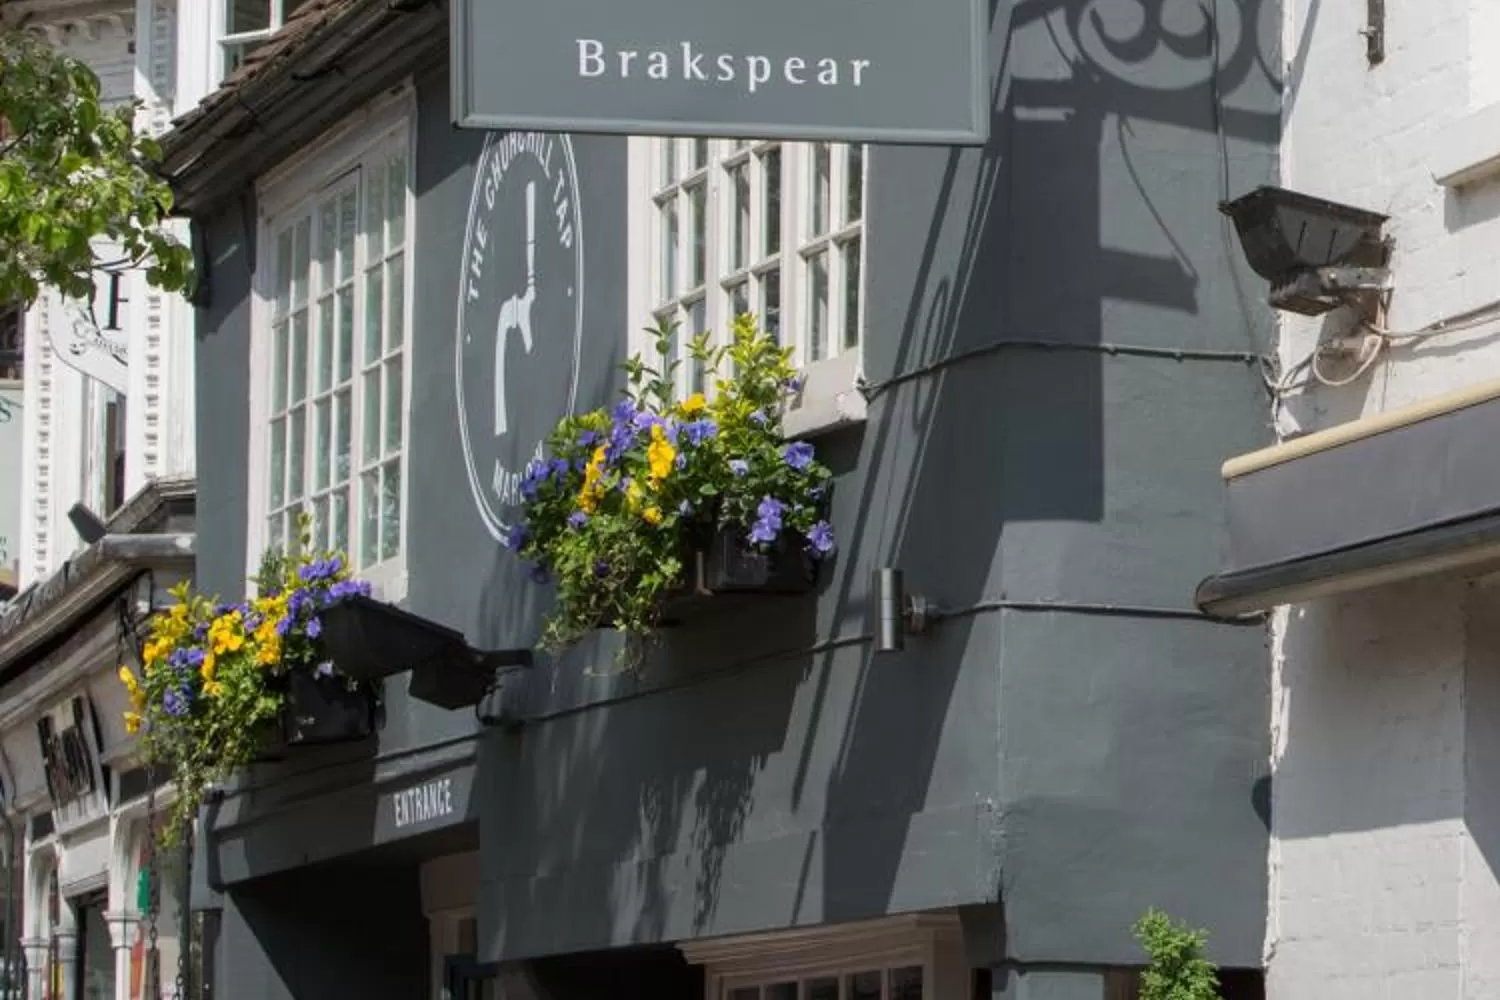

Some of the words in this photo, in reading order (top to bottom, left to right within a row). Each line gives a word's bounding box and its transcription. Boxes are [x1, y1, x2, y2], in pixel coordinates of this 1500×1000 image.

[576, 39, 871, 92] Brakspear
[468, 216, 488, 304] THE
[553, 167, 573, 249] TAP
[393, 778, 453, 828] ENTRANCE
